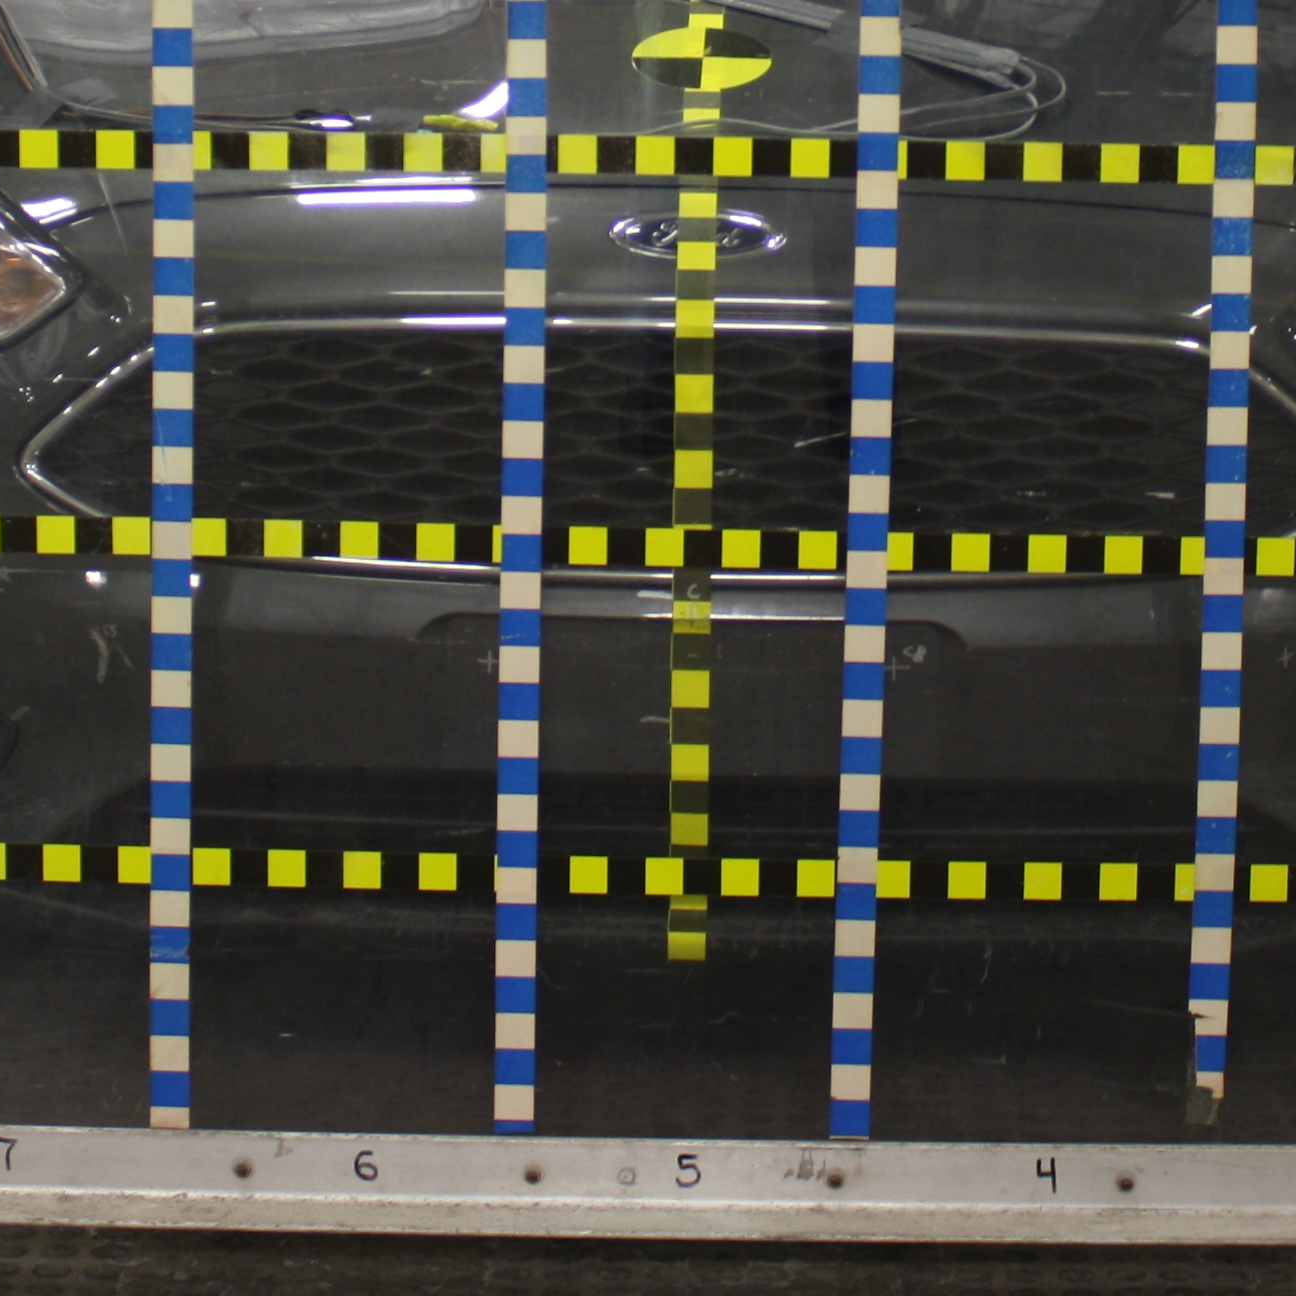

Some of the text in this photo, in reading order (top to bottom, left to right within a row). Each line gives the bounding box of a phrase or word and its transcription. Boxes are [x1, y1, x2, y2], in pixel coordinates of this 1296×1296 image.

[353, 1150, 380, 1183] 6
[674, 1153, 703, 1188] 5
[1036, 1158, 1058, 1194] 4
